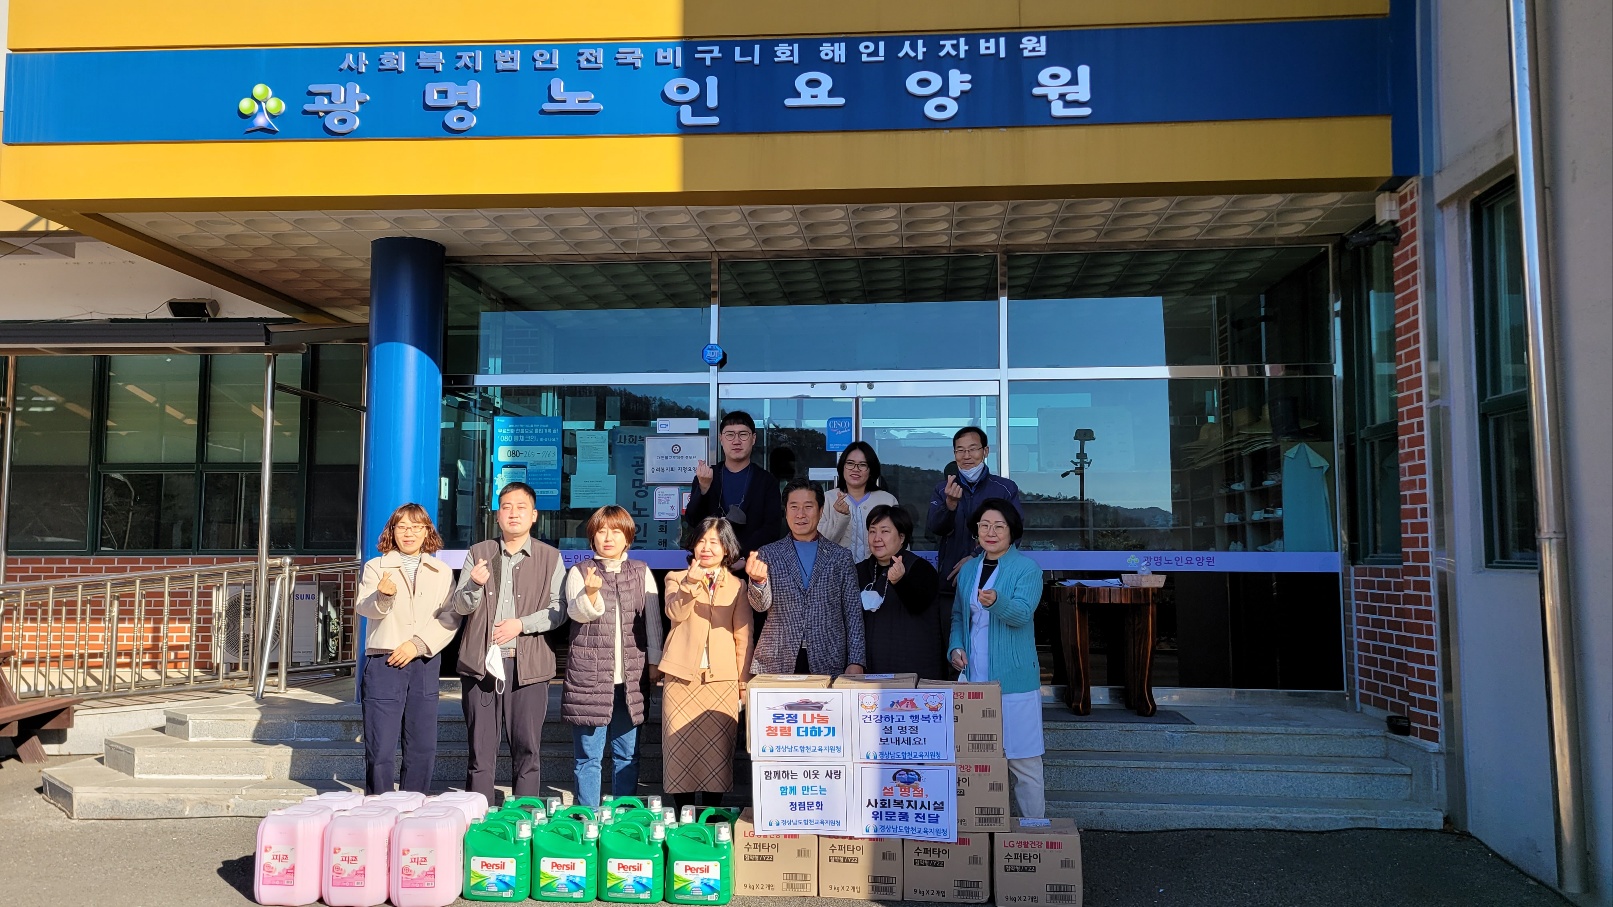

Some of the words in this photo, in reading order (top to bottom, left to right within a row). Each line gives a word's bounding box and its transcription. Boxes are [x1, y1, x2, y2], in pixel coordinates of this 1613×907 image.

[339, 48, 560, 74] 사회복지법인
[576, 43, 800, 71] 전국비구니회
[819, 35, 1048, 64] 해인사자비원
[302, 64, 1093, 134] 광명노인요양원
[829, 420, 850, 429] CESCO
[1142, 555, 1216, 567] 광명노인요양원
[772, 713, 798, 724] 온정
[802, 713, 830, 724] 나눔
[861, 714, 906, 723] 건강하고
[909, 713, 943, 723] 행복한
[766, 725, 792, 737] 청렴
[797, 725, 836, 737] 더하기
[882, 725, 893, 735] 설
[897, 725, 919, 735] 명절
[879, 736, 927, 746] 보내세요!
[764, 770, 799, 780] 함께하는
[803, 769, 820, 780] 이웃
[825, 769, 842, 780] 사랑
[779, 785, 797, 796] 함께
[801, 785, 827, 796] 만드는
[882, 786, 894, 797] 설
[899, 786, 929, 798] 명절,
[866, 798, 945, 812] 사회복지시설
[871, 811, 910, 822] 위문품
[914, 812, 941, 825] 전달
[743, 842, 779, 853] 수퍼타이
[829, 844, 864, 855] 수퍼타이
[1003, 840, 1015, 848] LG
[1015, 840, 1044, 849] 생활건강
[913, 846, 950, 859] 수퍼타이
[1003, 852, 1042, 863] 수퍼타이
[480, 860, 506, 870] Persil
[550, 861, 576, 871] Persil
[617, 862, 643, 872] Persil
[684, 864, 710, 874] Persil
